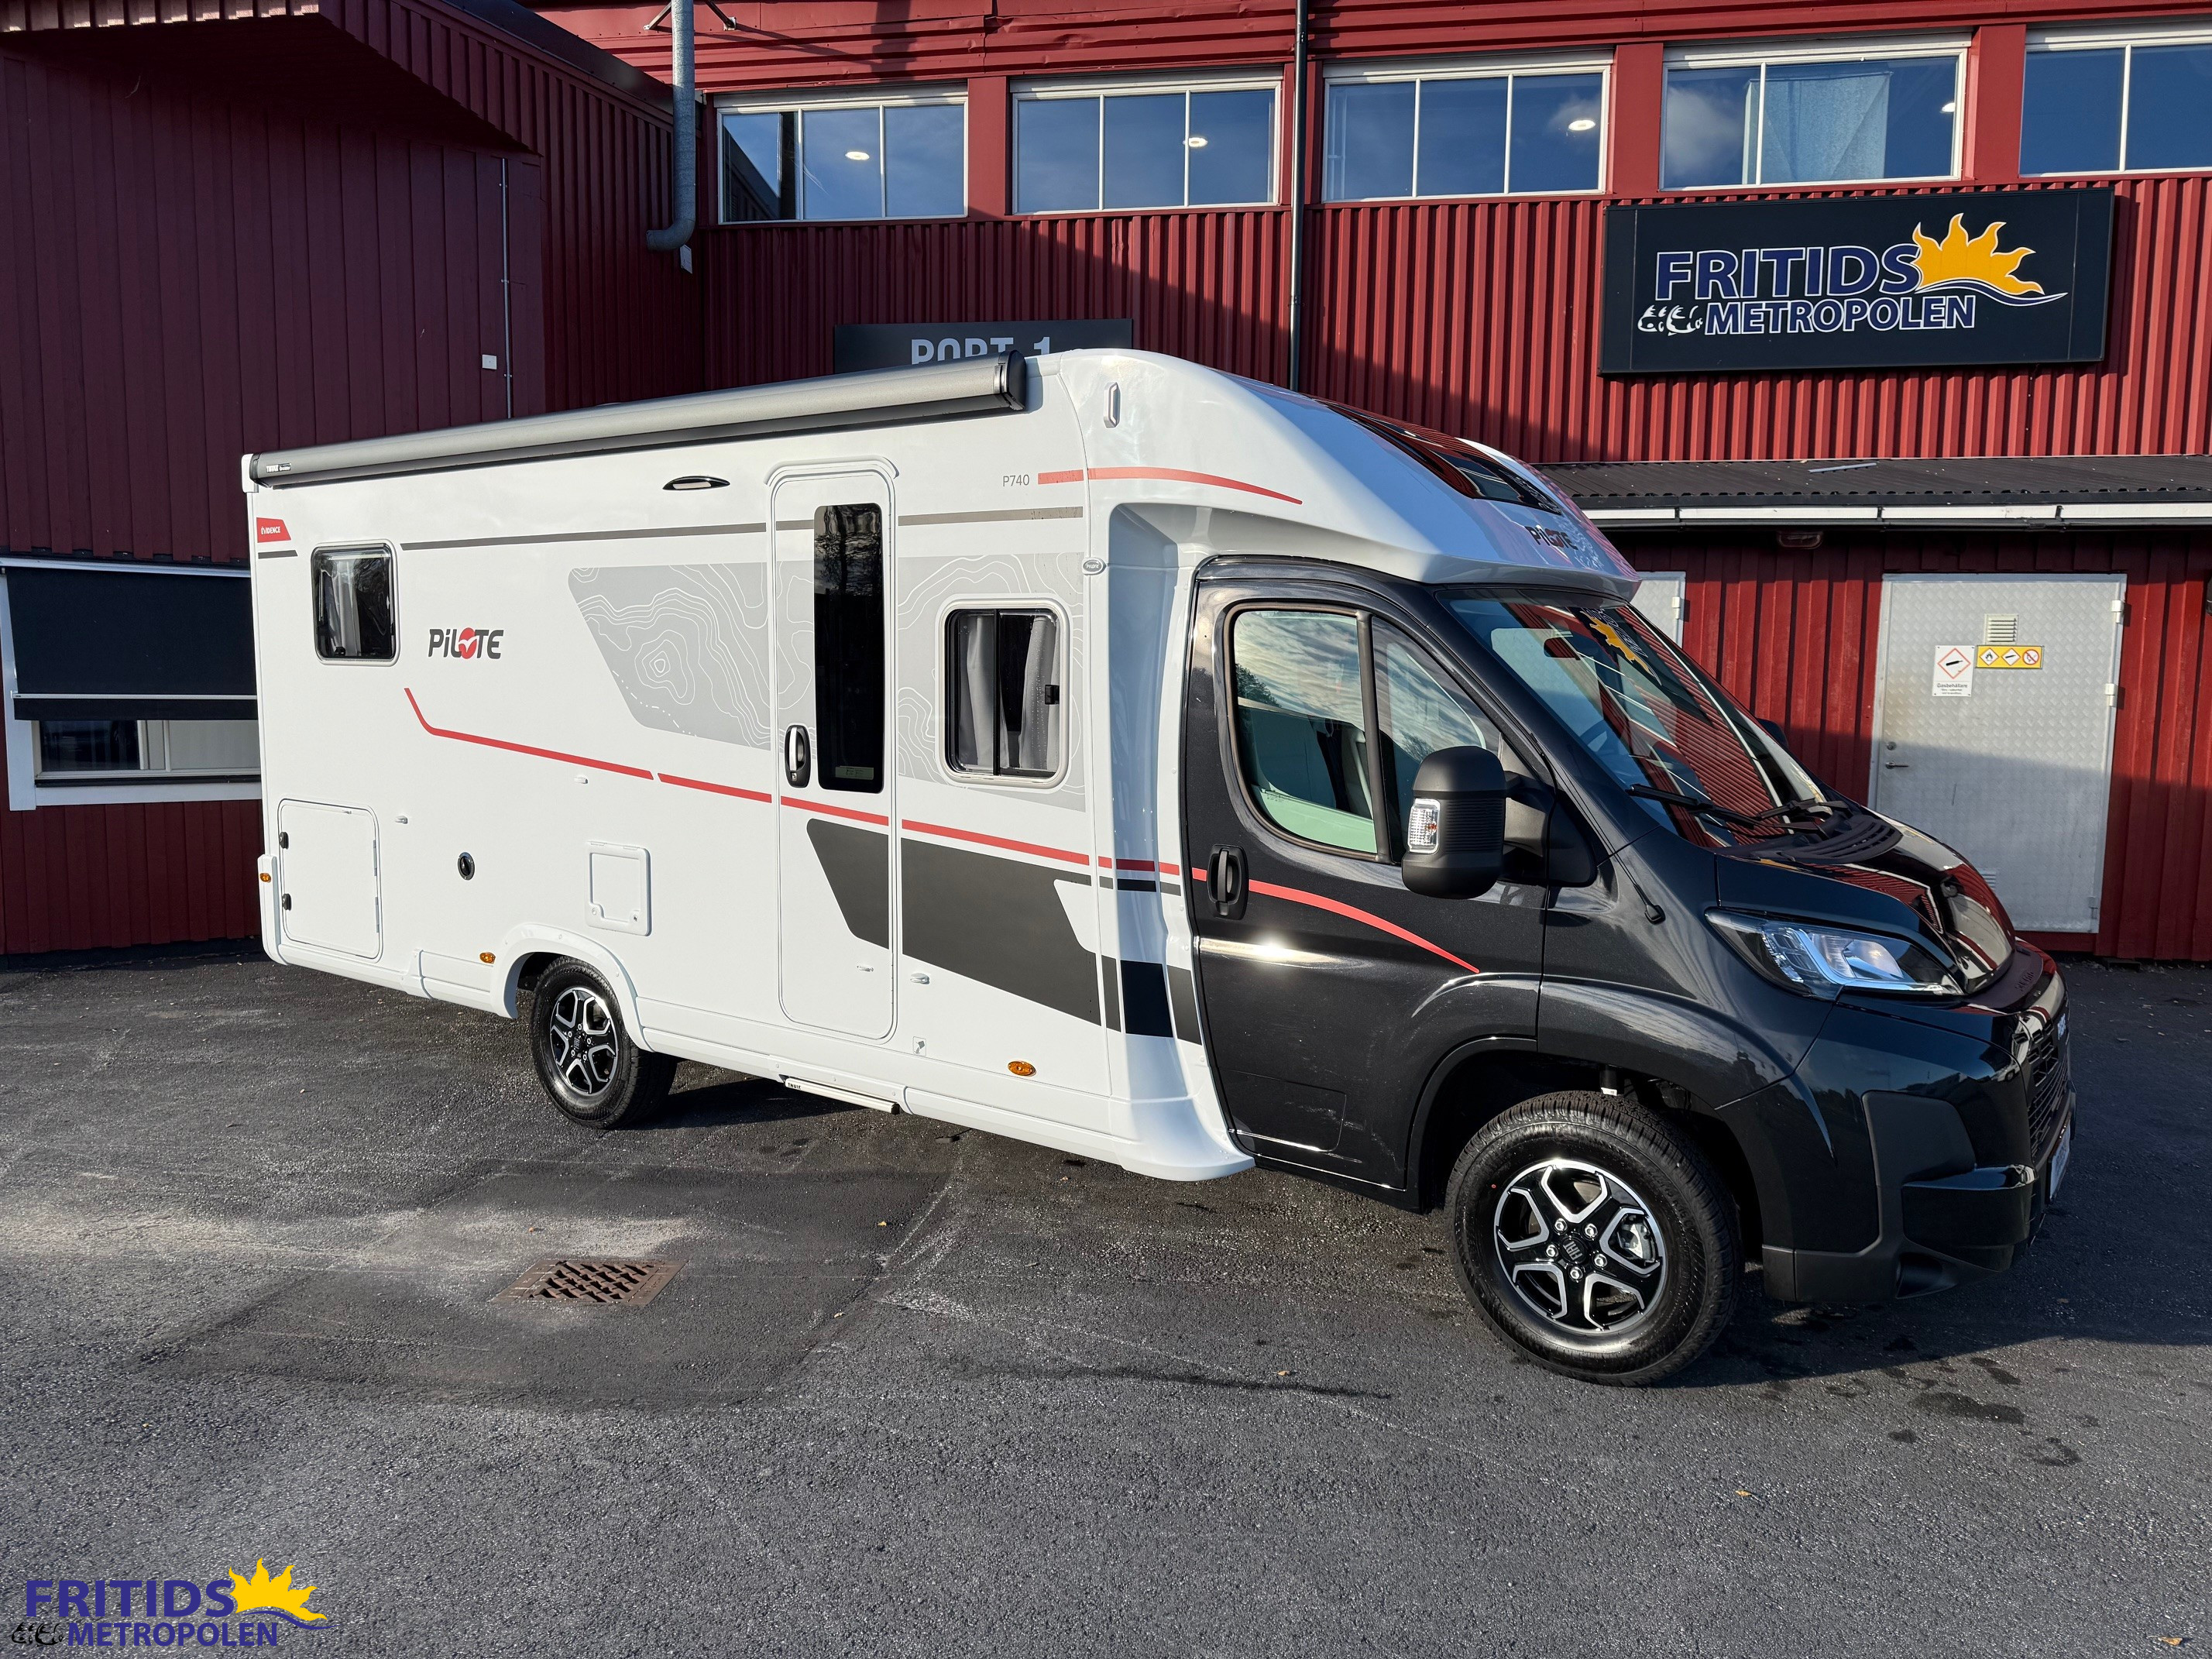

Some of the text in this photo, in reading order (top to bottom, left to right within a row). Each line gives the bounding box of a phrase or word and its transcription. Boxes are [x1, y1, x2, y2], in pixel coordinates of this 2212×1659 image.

[1655, 243, 1921, 302] FRITIDS
[1703, 295, 1977, 336] METROPOLEN
[1002, 474, 1030, 486] P740
[1563, 1241, 1583, 1261] FIAT
